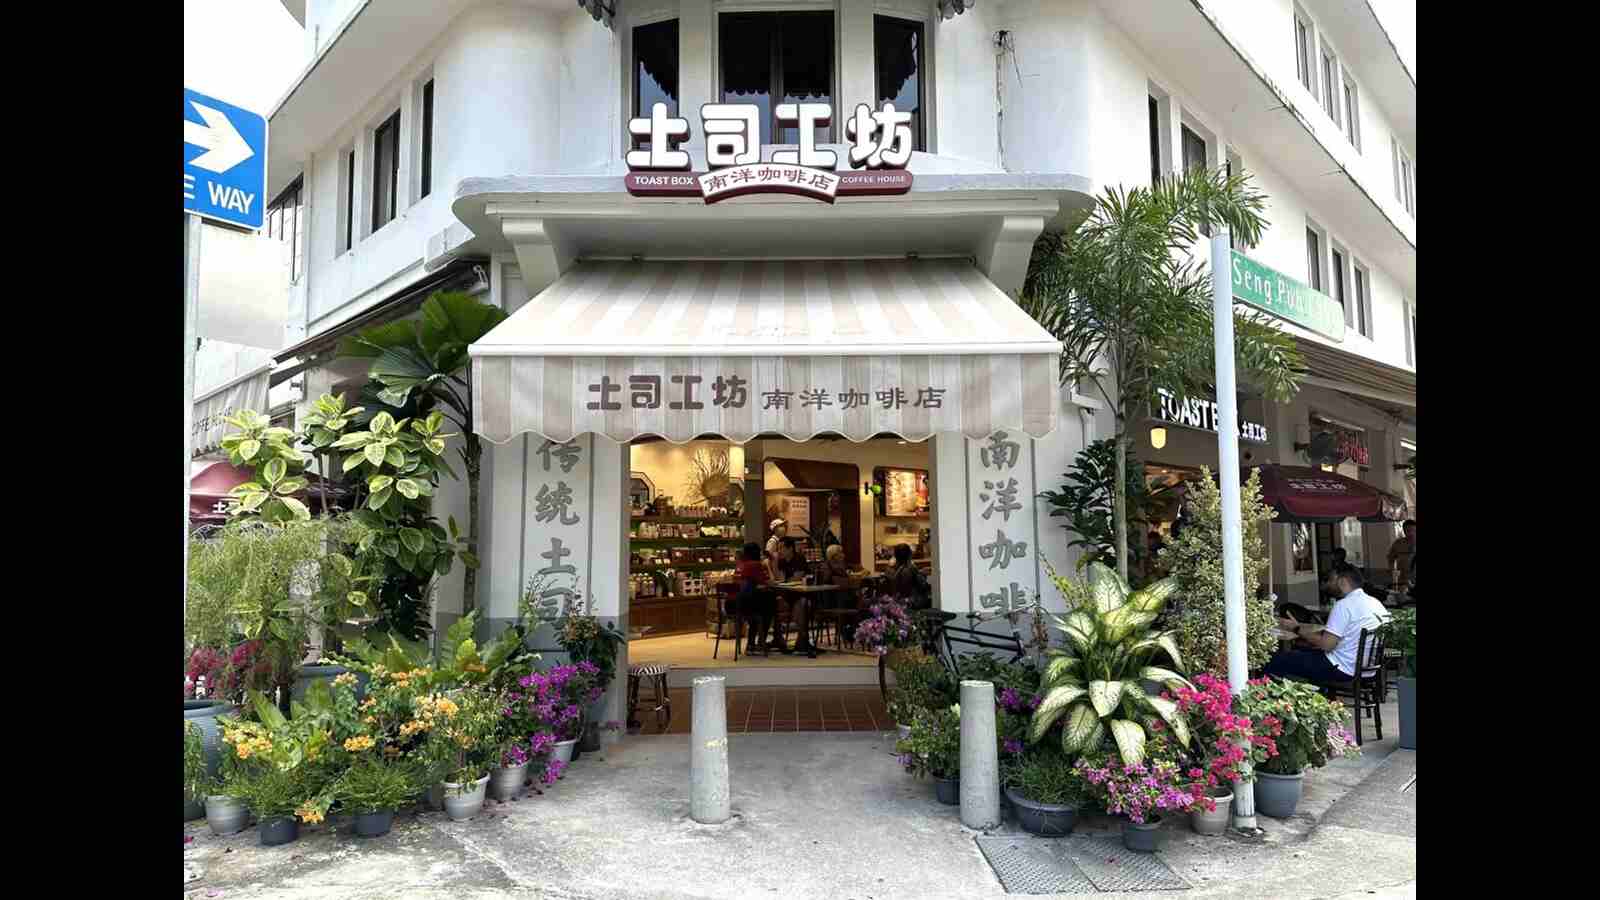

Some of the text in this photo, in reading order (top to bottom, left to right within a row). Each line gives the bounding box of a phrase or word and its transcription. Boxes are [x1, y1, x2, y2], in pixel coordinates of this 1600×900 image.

[624, 102, 912, 168] 土司工坊
[208, 181, 254, 214] WAY
[634, 175, 694, 186] TOAST BOX
[704, 167, 832, 191] 南洋咖啡店
[842, 174, 905, 185] COFFEE HOUSE
[1232, 258, 1272, 304] Seng
[587, 374, 947, 411] 土司工坊 南洋咖啡店
[1157, 387, 1210, 429] TOAST
[535, 439, 583, 623] 传统土司
[978, 429, 1028, 625] 南洋咖啡
